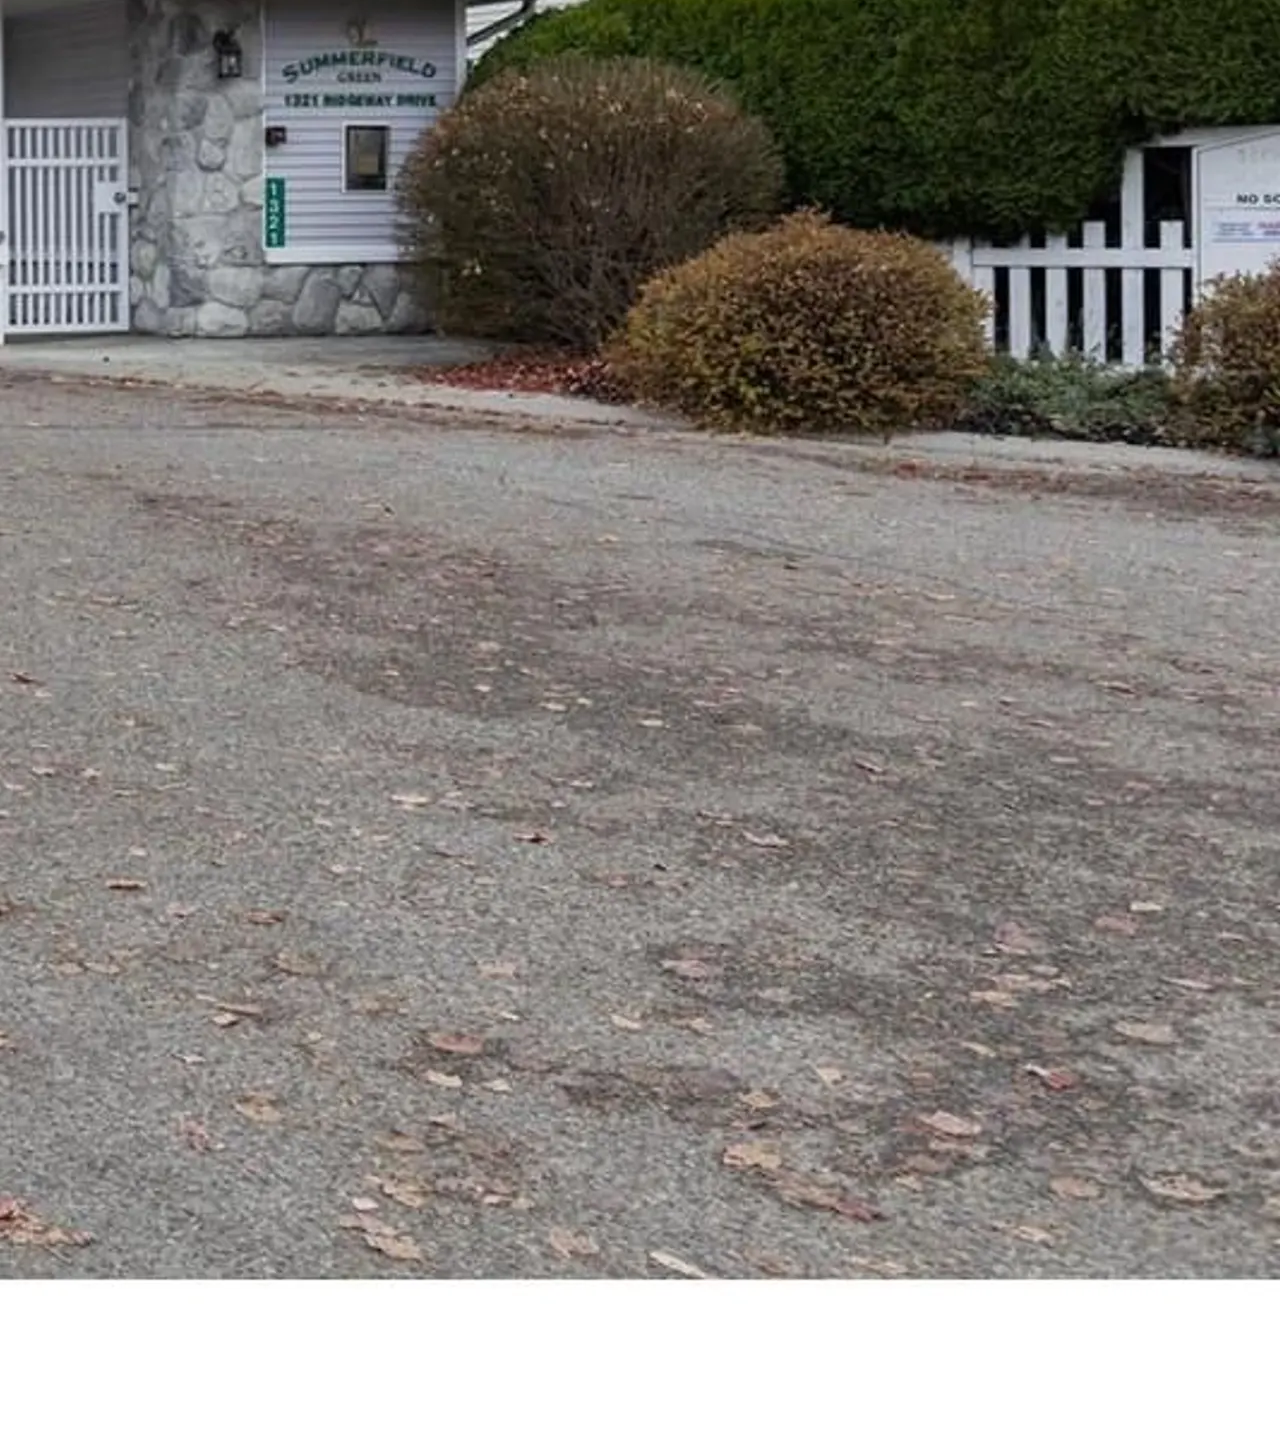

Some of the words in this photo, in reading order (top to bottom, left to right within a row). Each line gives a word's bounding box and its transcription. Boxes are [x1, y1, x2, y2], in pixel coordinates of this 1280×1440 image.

[281, 50, 437, 84] SUMMERFIELD
[336, 71, 382, 83] GREEN
[284, 93, 319, 107] 1321
[323, 93, 393, 107] RIDGEWAY
[396, 93, 437, 107] DRIVE
[1237, 193, 1259, 205] NO
[269, 181, 280, 245] 1321
